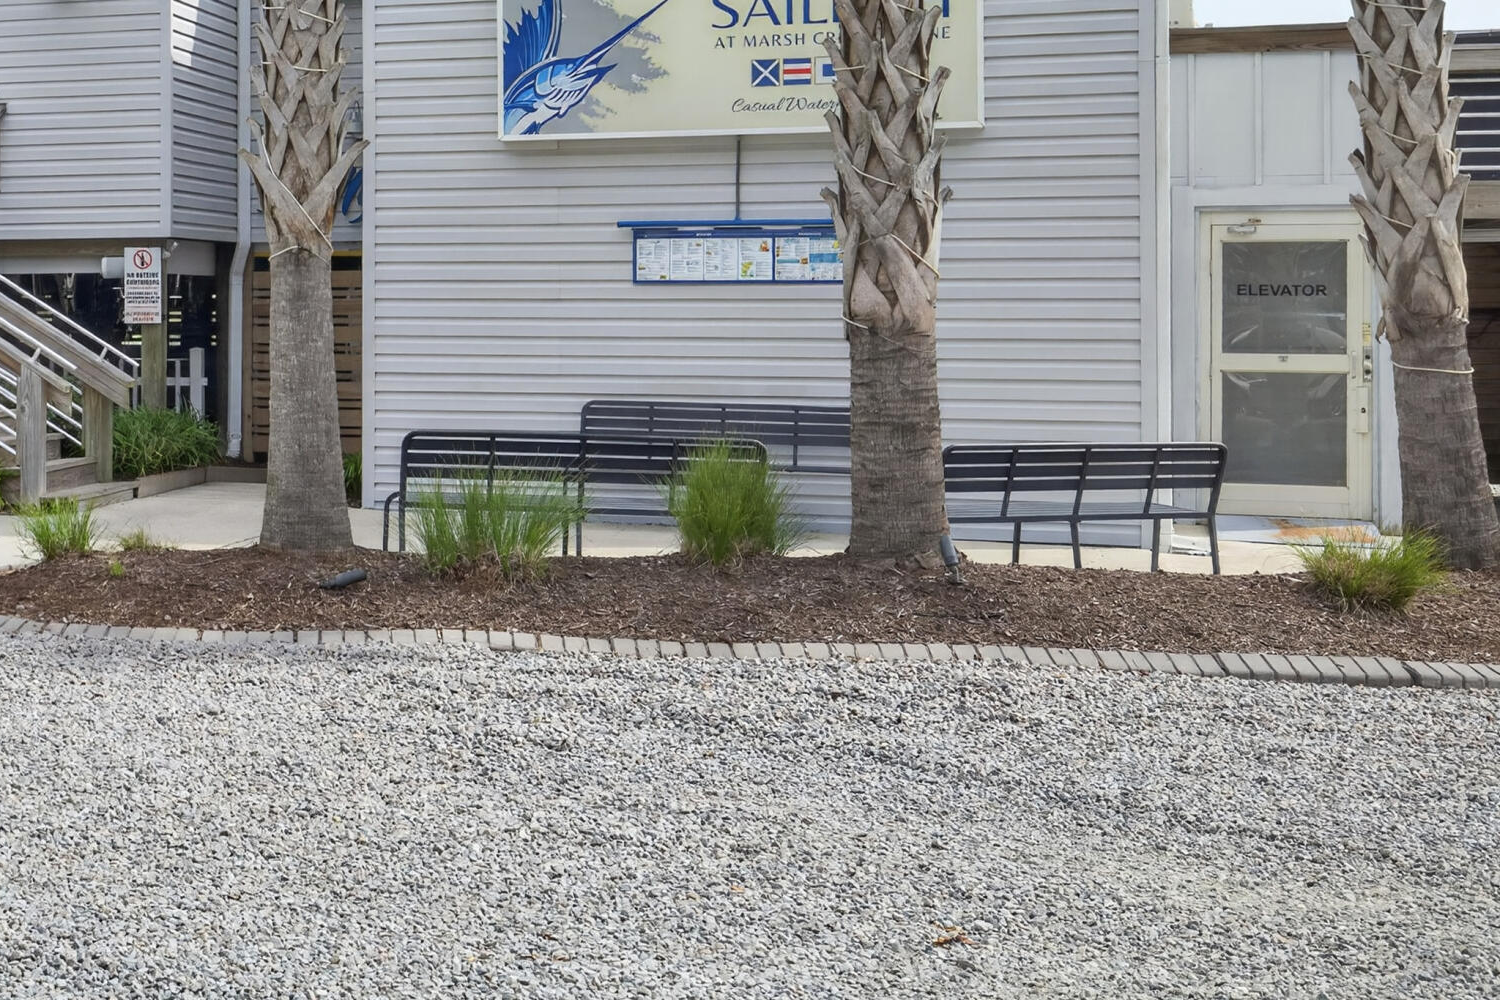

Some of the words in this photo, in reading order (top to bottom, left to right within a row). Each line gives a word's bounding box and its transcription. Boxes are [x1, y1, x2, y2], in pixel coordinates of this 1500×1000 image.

[715, 35, 736, 49] AT
[743, 33, 806, 48] MARSH
[731, 96, 786, 113] Casual
[1236, 283, 1328, 297] ELEVATOR
